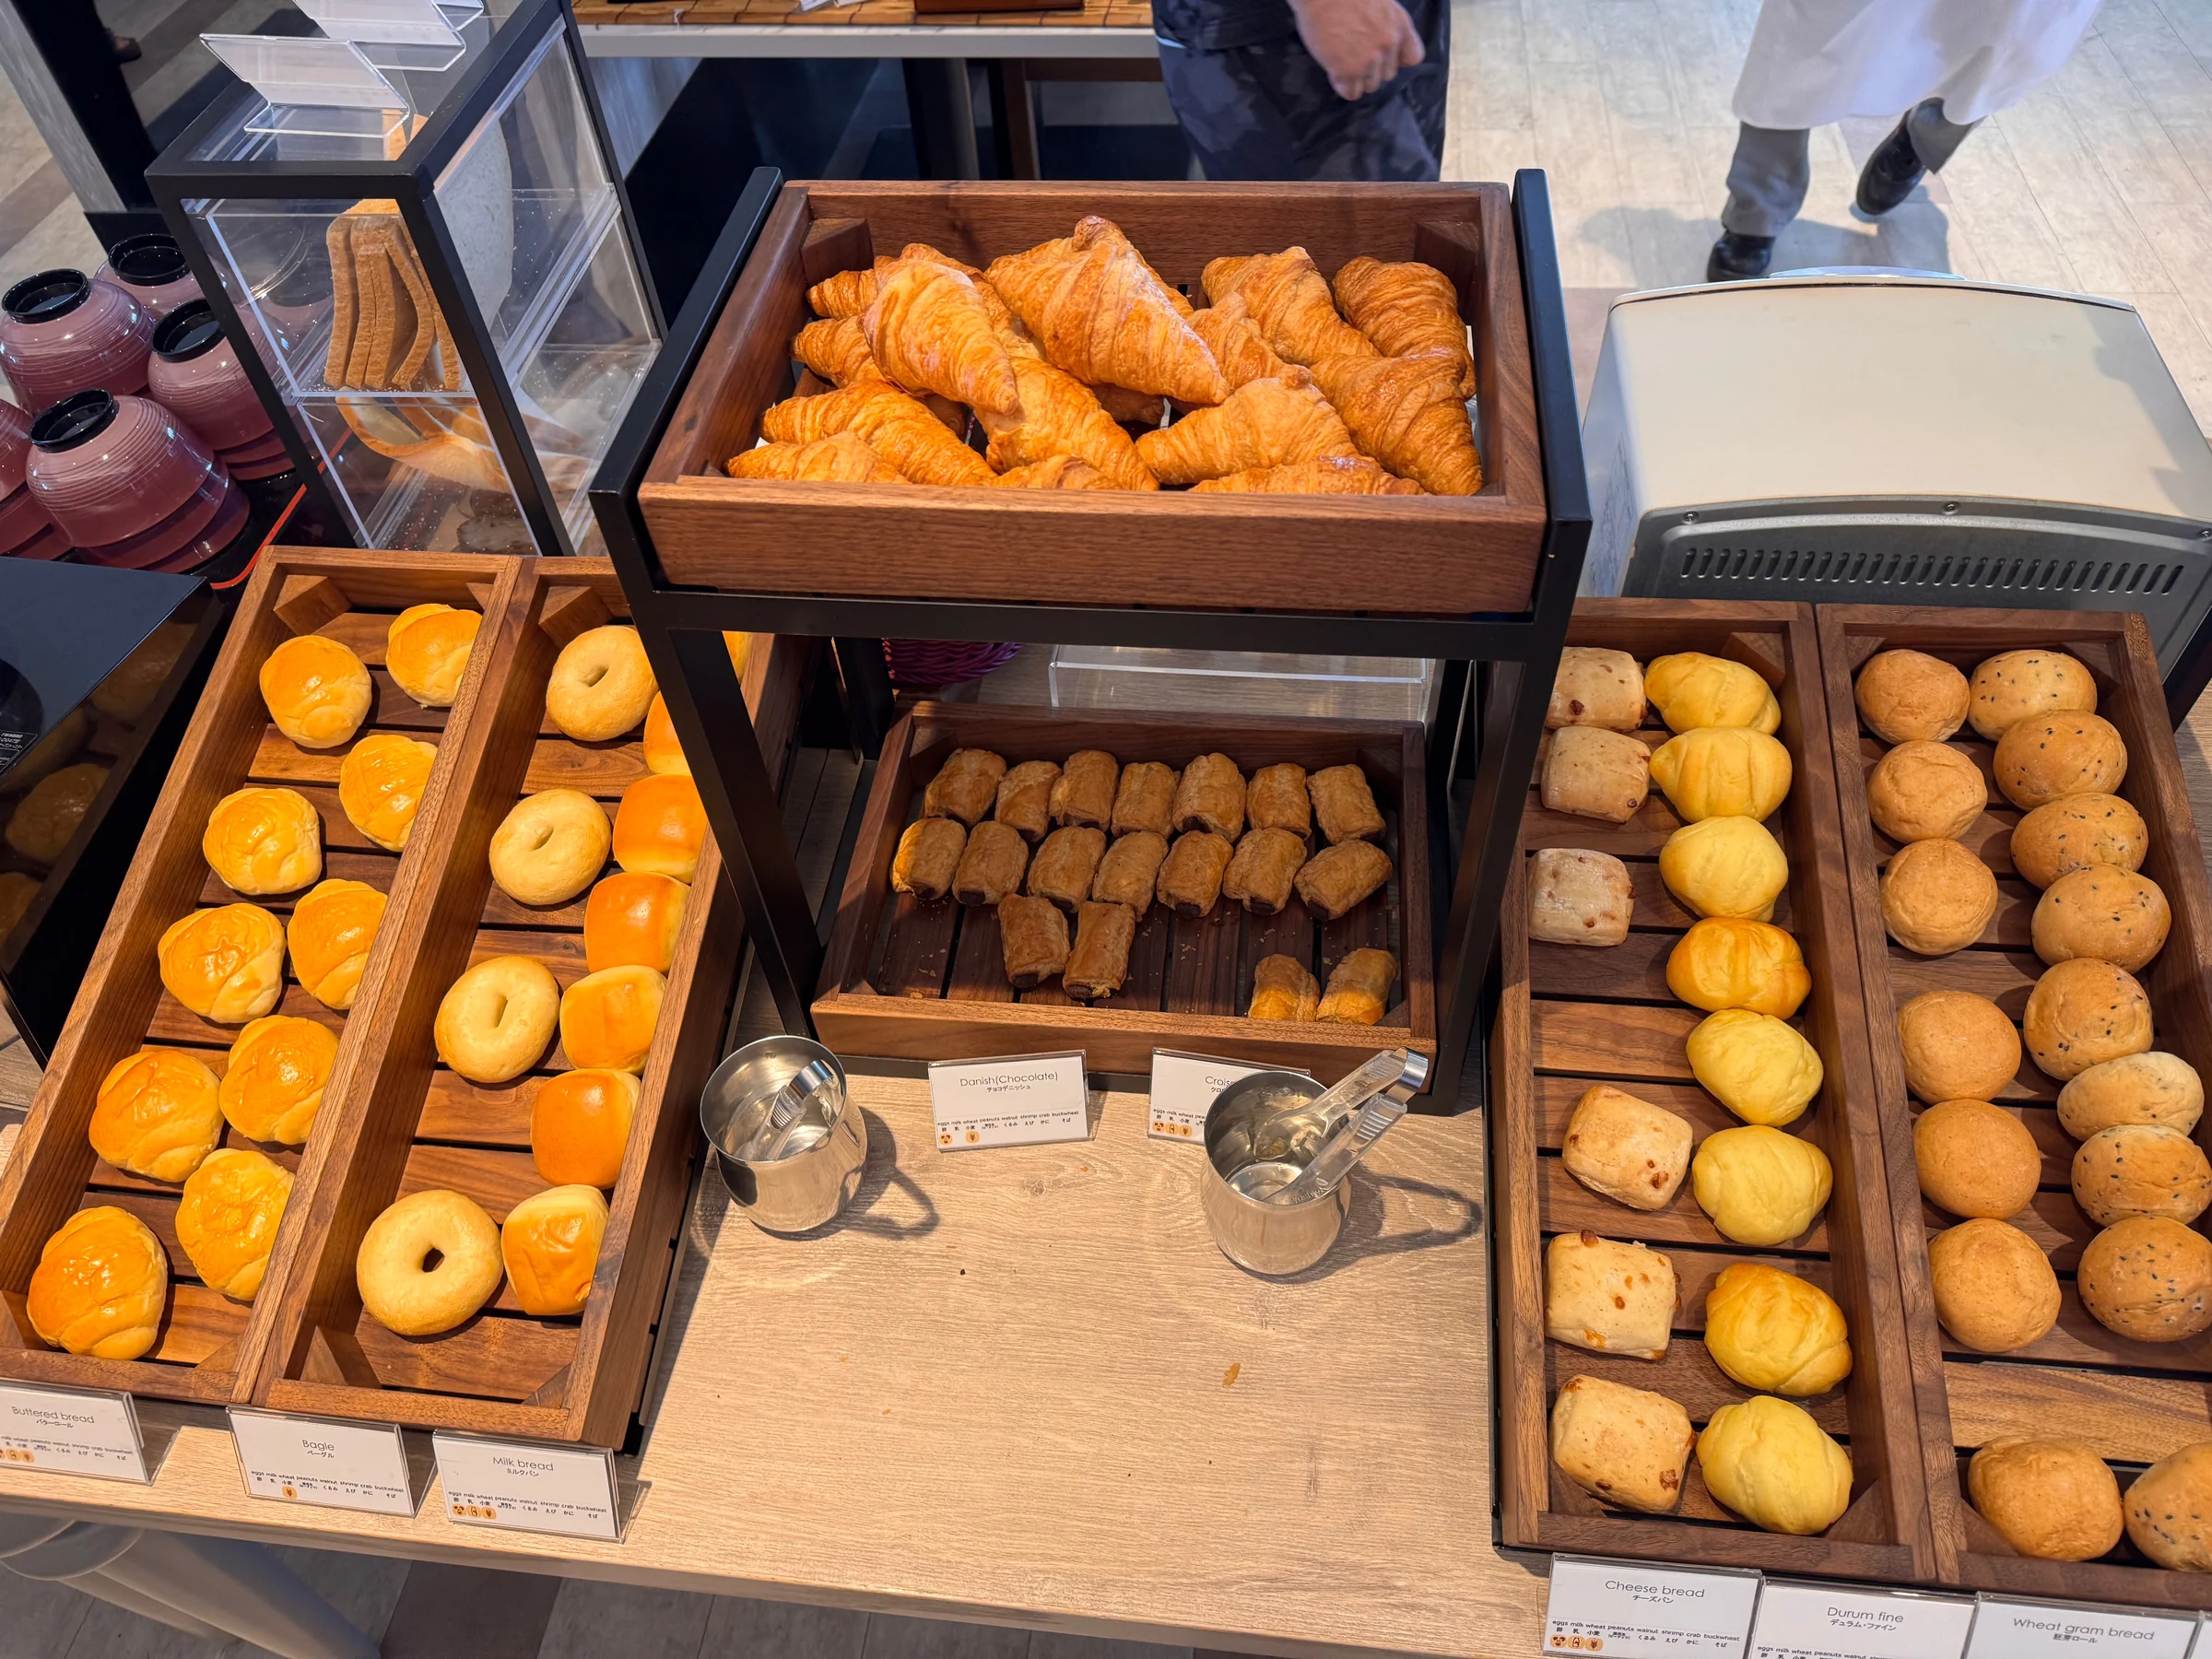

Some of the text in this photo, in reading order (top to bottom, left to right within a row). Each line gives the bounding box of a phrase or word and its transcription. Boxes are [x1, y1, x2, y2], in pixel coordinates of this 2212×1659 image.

[960, 1071, 1058, 1087] Danish(Chocolate)
[1205, 1076, 1235, 1087] Crois
[986, 1084, 1031, 1093] チョコデニッシュ
[12, 1406, 95, 1424] Buttered bread
[301, 1439, 335, 1452] Bagle
[492, 1456, 554, 1471] Milk bread
[506, 1468, 539, 1477] ミルクパン
[1605, 1580, 1705, 1598] Cheese bread
[1632, 1594, 1674, 1604] チーズパン
[1827, 1606, 1904, 1623] Durum fine
[2013, 1618, 2156, 1641] Wheat gram bread
[1703, 1633, 1740, 1641] buckwheat
